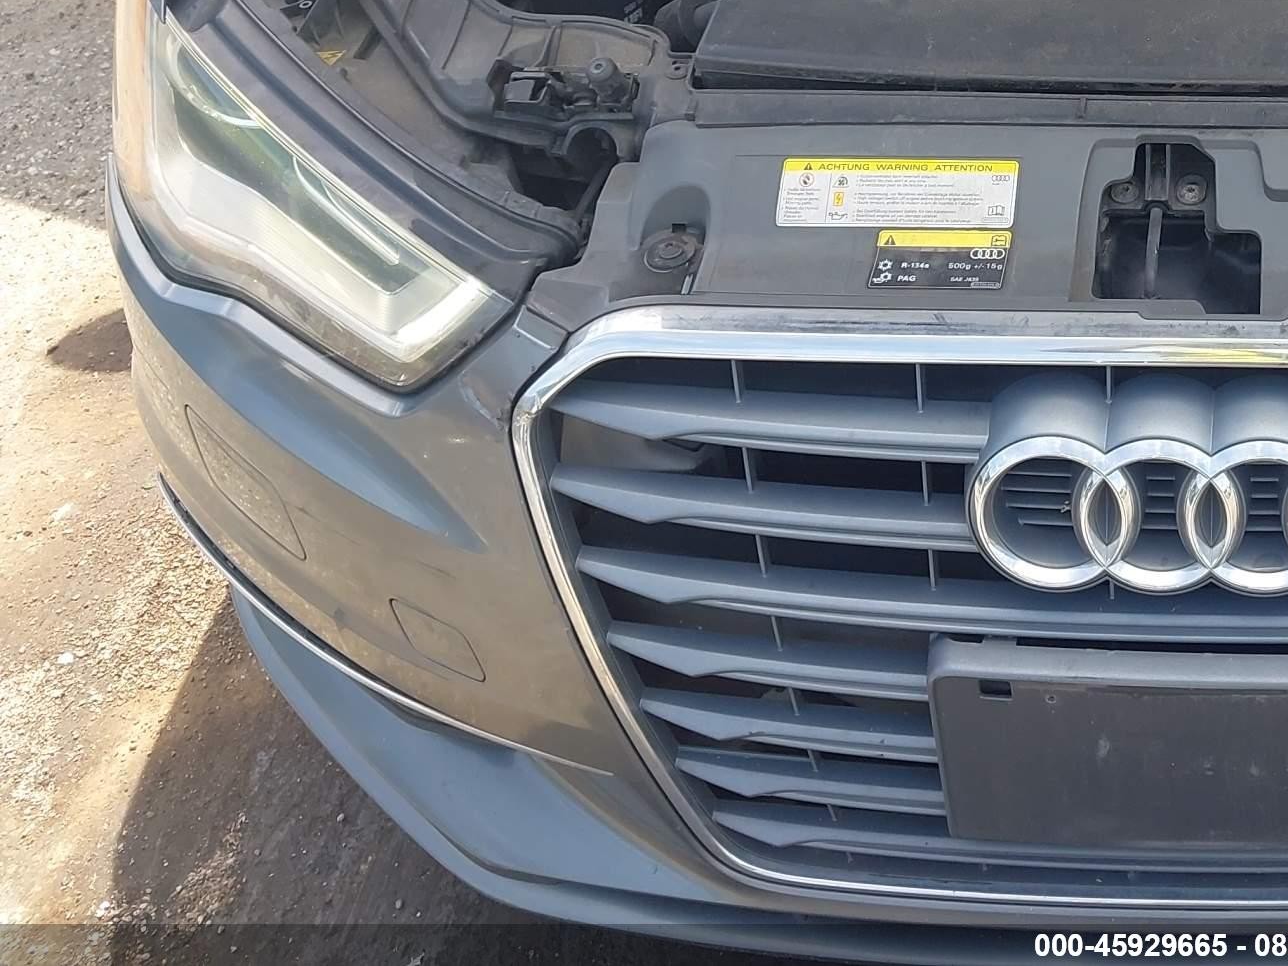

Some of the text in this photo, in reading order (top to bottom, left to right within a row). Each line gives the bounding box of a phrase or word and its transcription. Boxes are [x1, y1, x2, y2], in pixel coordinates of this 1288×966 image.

[818, 163, 993, 172] ACHTUNG WARNING ATTENTION
[948, 262, 971, 270] 500g
[986, 263, 1003, 271] 15g
